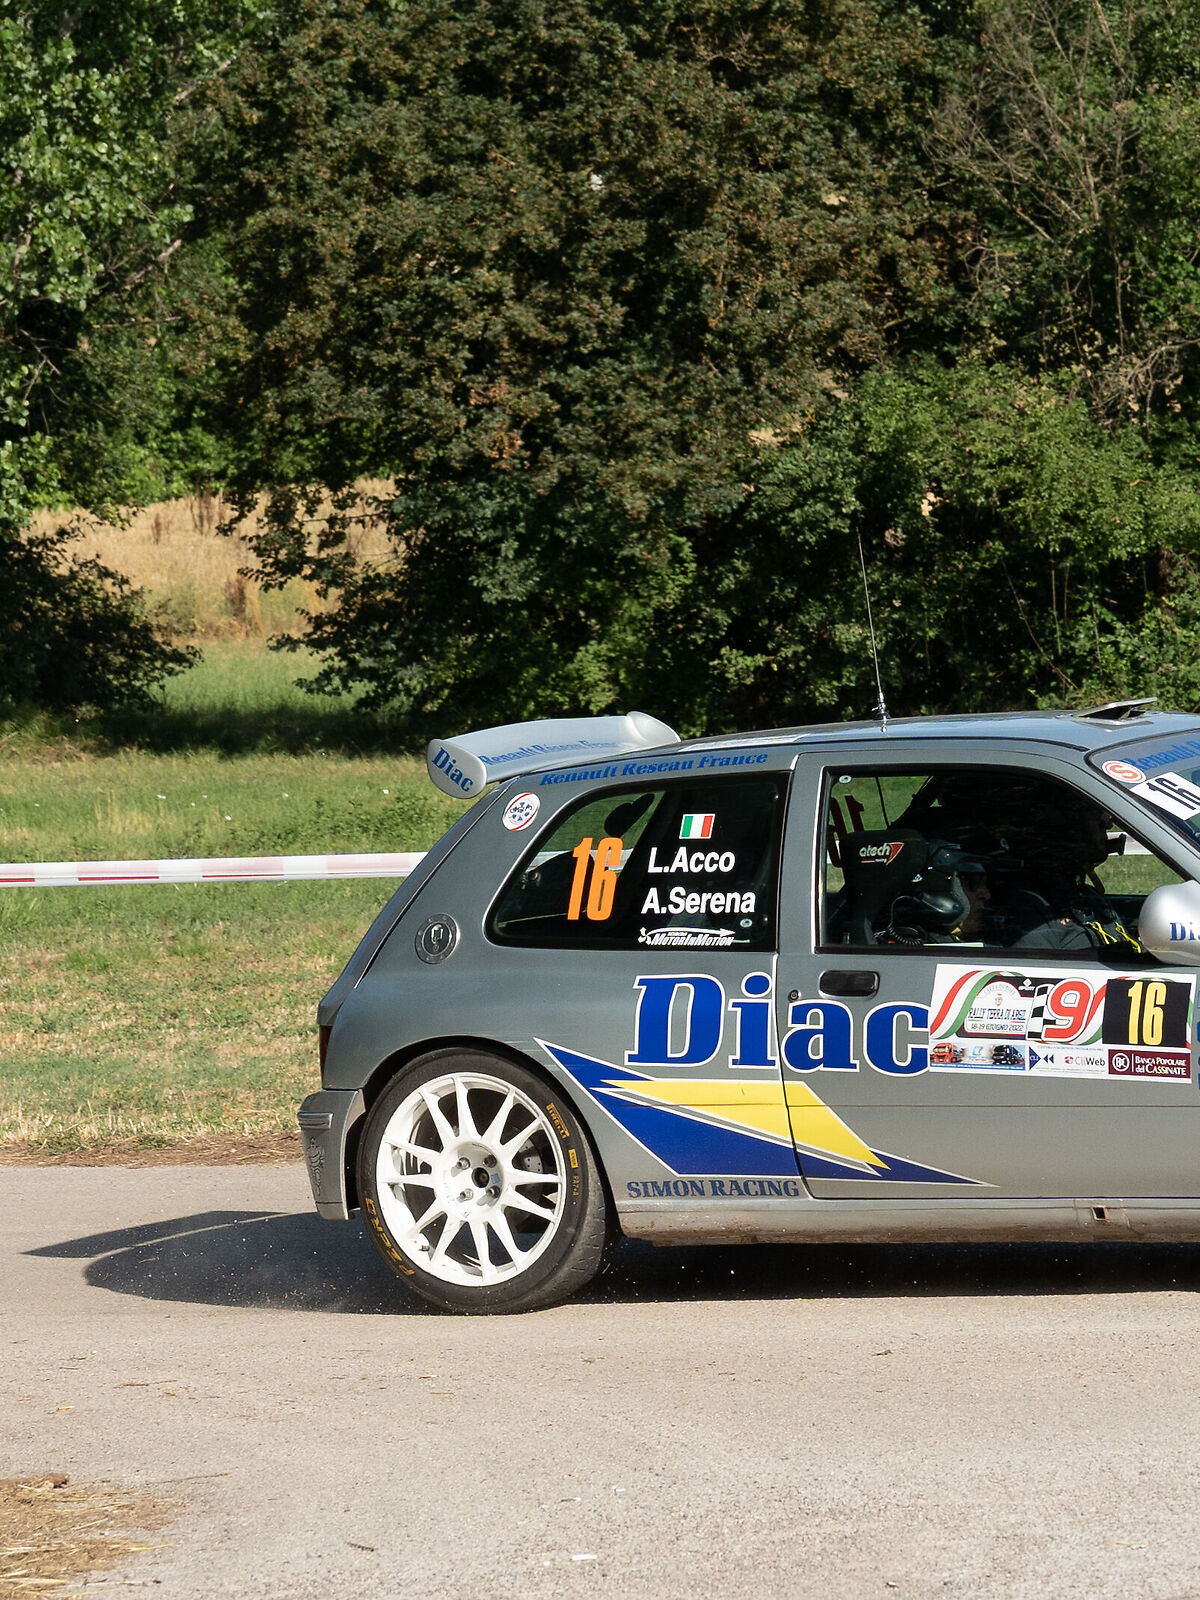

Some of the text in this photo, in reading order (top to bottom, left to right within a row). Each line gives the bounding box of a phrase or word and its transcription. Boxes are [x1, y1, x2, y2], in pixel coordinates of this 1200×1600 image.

[432, 747, 474, 792] Diac
[539, 752, 768, 786] Renault Reseau France
[648, 846, 735, 874] L.Acco
[567, 836, 624, 921] 16
[641, 886, 756, 914] A.Serena
[623, 972, 930, 1076] Diac
[1043, 978, 1095, 1041] 9
[1128, 981, 1168, 1046] 16
[1008, 1024, 1024, 1032] 2022
[1074, 1055, 1106, 1067] CliWeb
[1145, 1064, 1187, 1076] CASSINATE
[626, 1179, 800, 1199] SIMON RACING
[366, 1197, 403, 1263] ZERO
